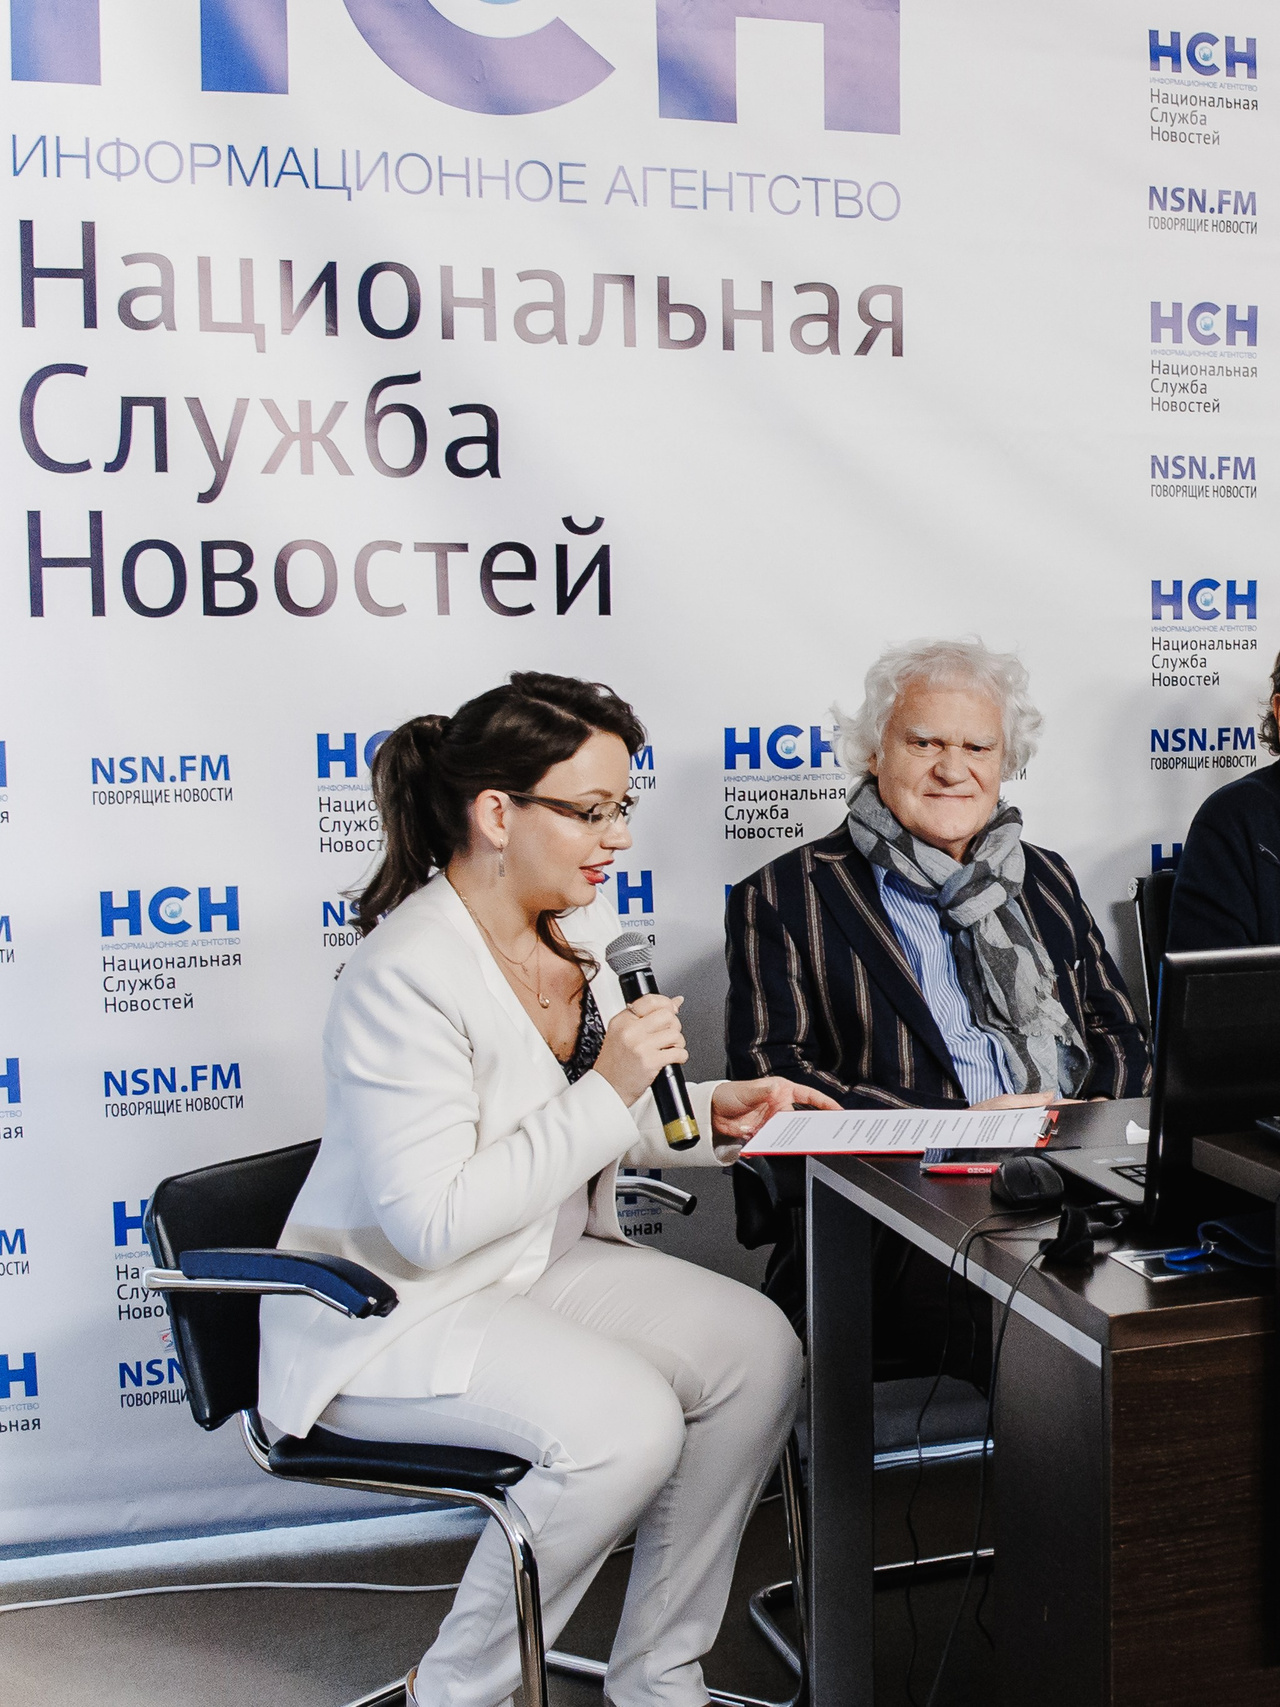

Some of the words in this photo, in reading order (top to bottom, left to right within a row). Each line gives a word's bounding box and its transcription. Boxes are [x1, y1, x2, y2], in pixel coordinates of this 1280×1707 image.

[1148, 29, 1257, 79] НСН
[1151, 88, 1258, 110] Национальная
[1150, 107, 1206, 127] Служба
[1151, 126, 1219, 145] Новостей
[11, 134, 588, 204] ИНФОРМАЦИОННОЕ
[605, 166, 902, 222] АГЕНТСТВО
[1149, 186, 1256, 216] NSN.FM
[18, 219, 905, 357] Национальная
[1151, 301, 1258, 346] НСН
[18, 363, 502, 503] Служба
[1151, 455, 1256, 480] NSN.FM
[27, 510, 613, 618] Новостей
[1151, 578, 1257, 620] НСН
[1152, 636, 1257, 653] Национальная
[1152, 654, 1207, 672] Служба
[1152, 672, 1219, 687] Новостей
[1151, 727, 1256, 753] NSN.FM
[91, 754, 230, 785] NSN.FM
[1150, 756, 1209, 771] ГОВОРЯЩИЕ
[1213, 754, 1257, 769] НОВОСТИ
[92, 789, 170, 806] ГОВОРЯЩИЕ
[174, 787, 233, 803] НОВОСТИ
[724, 787, 847, 804] Национальная
[725, 804, 789, 824] Служба
[319, 816, 379, 836] Служб
[725, 823, 803, 841] Новостей
[320, 837, 384, 853] Новост
[100, 886, 240, 937] НСН
[103, 953, 241, 973] Национальная
[103, 973, 176, 996] Служба
[104, 993, 193, 1013] Новостей
[104, 1063, 241, 1098] NSN.FM
[121, 1389, 187, 1408] ГОВОРЯЩИ
